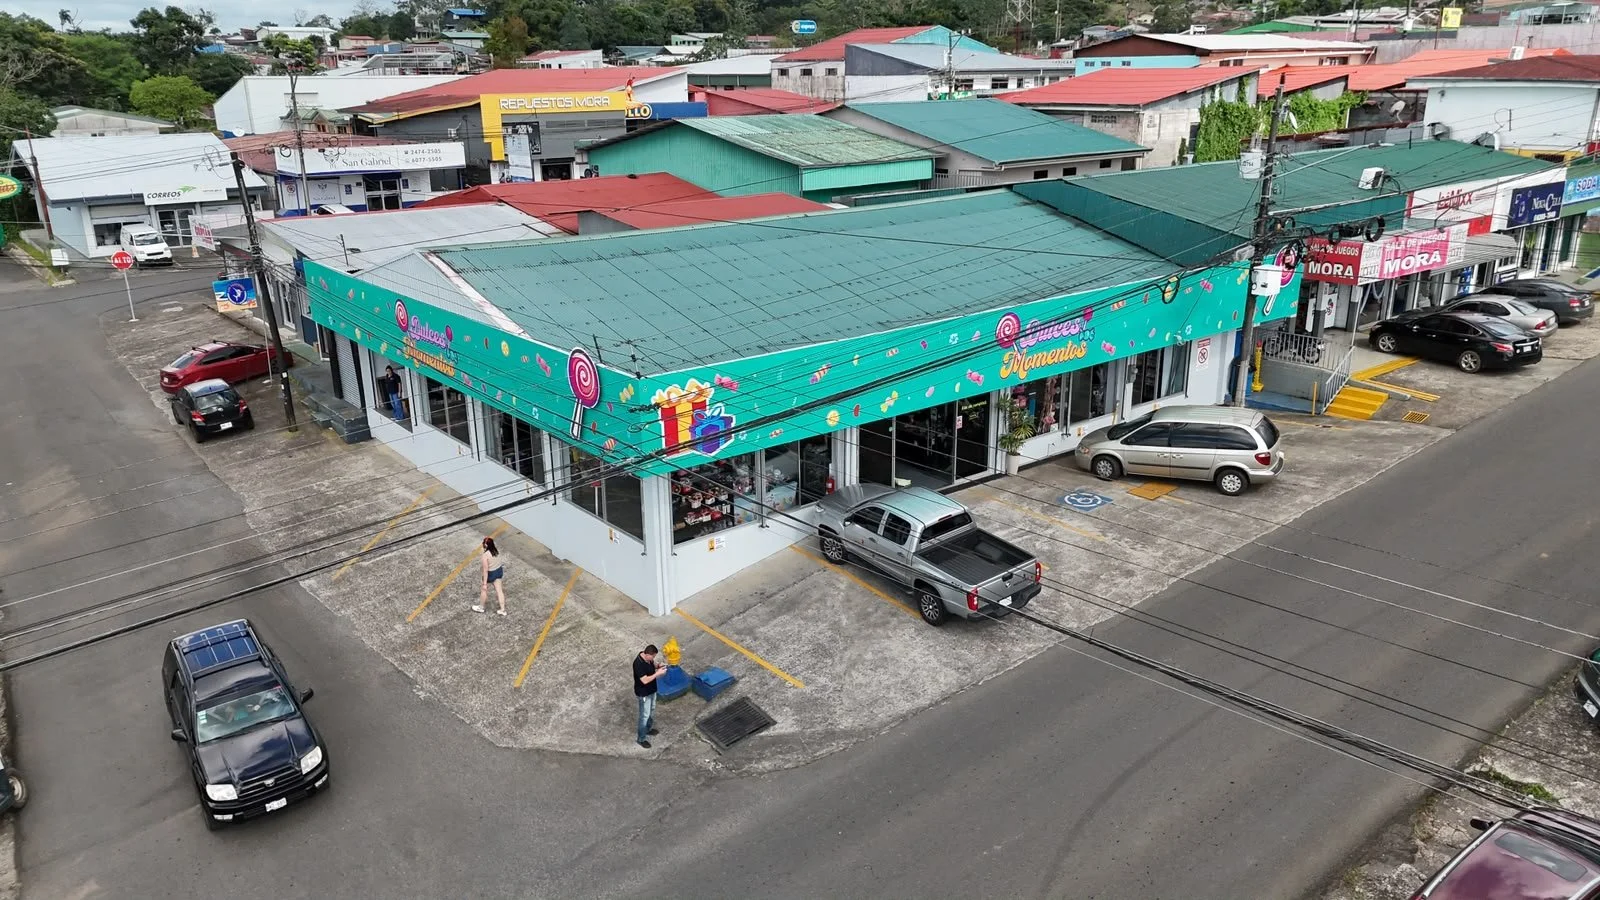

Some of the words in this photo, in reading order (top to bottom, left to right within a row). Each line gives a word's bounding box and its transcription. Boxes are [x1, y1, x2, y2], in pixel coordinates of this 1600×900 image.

[500, 96, 573, 110] REPUESTOS
[575, 96, 611, 107] MORA
[624, 106, 651, 118] LLO
[342, 158, 359, 167] San
[360, 156, 392, 166] Gabriel
[1576, 175, 1597, 192] SODA
[146, 191, 181, 199] CORREOS
[1385, 239, 1406, 250] SALA
[1407, 237, 1417, 248] DE
[1417, 232, 1447, 246] JUEGOS
[1326, 245, 1335, 254] DE
[1335, 245, 1359, 257] JUEGOS
[113, 256, 132, 264] ALTO
[1383, 249, 1442, 275] MORA
[1308, 261, 1355, 277] MORA
[407, 315, 449, 349] Dulces
[1020, 318, 1081, 349] Dulces
[403, 336, 456, 378] Momentos
[1000, 340, 1088, 380] Momentos
